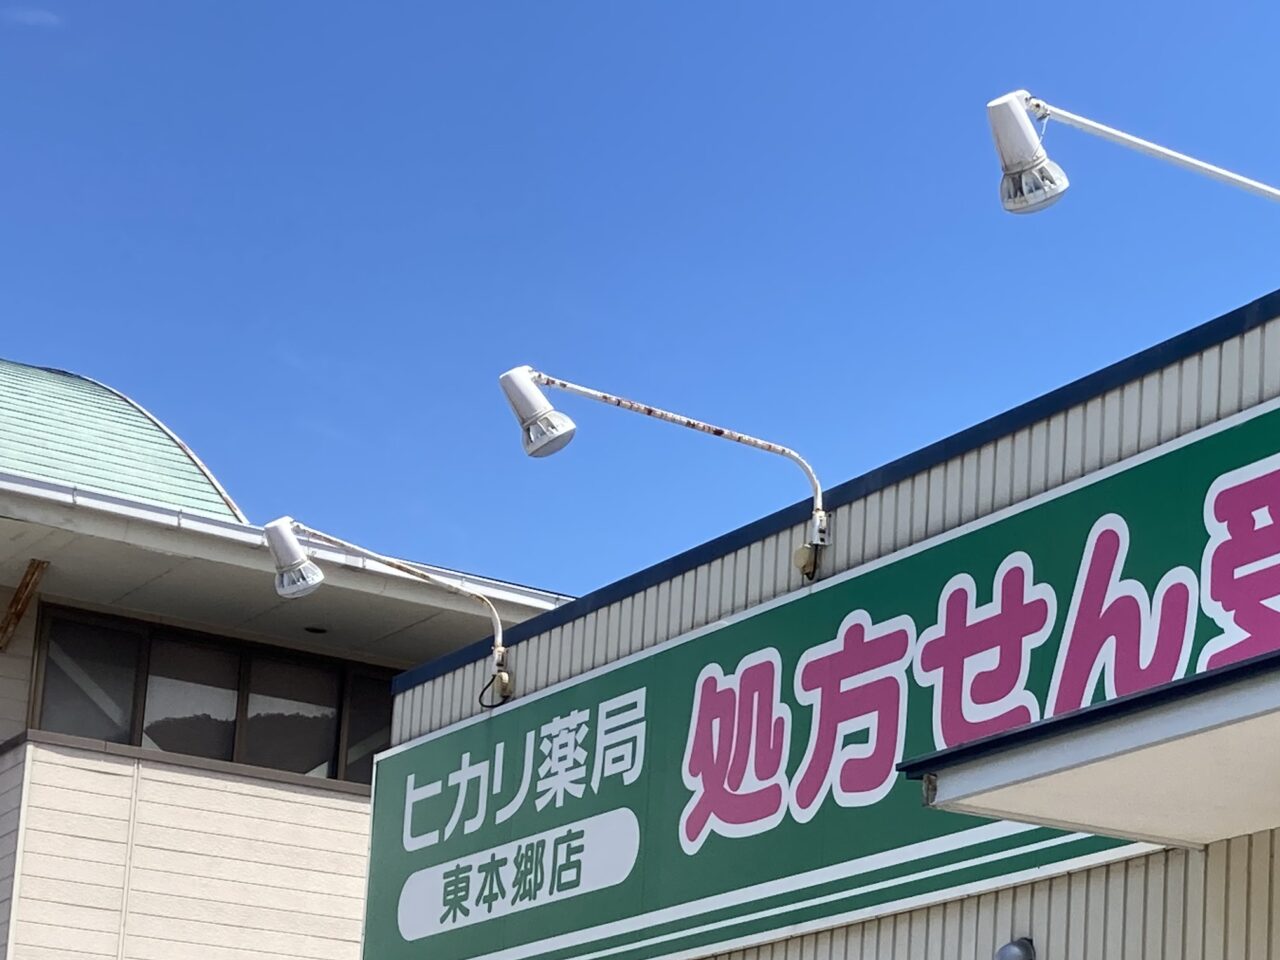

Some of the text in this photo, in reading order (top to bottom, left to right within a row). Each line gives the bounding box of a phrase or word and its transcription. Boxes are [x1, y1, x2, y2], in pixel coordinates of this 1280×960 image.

[402, 686, 647, 852] ヒカリ薬局
[439, 828, 585, 924] 東本郷店
